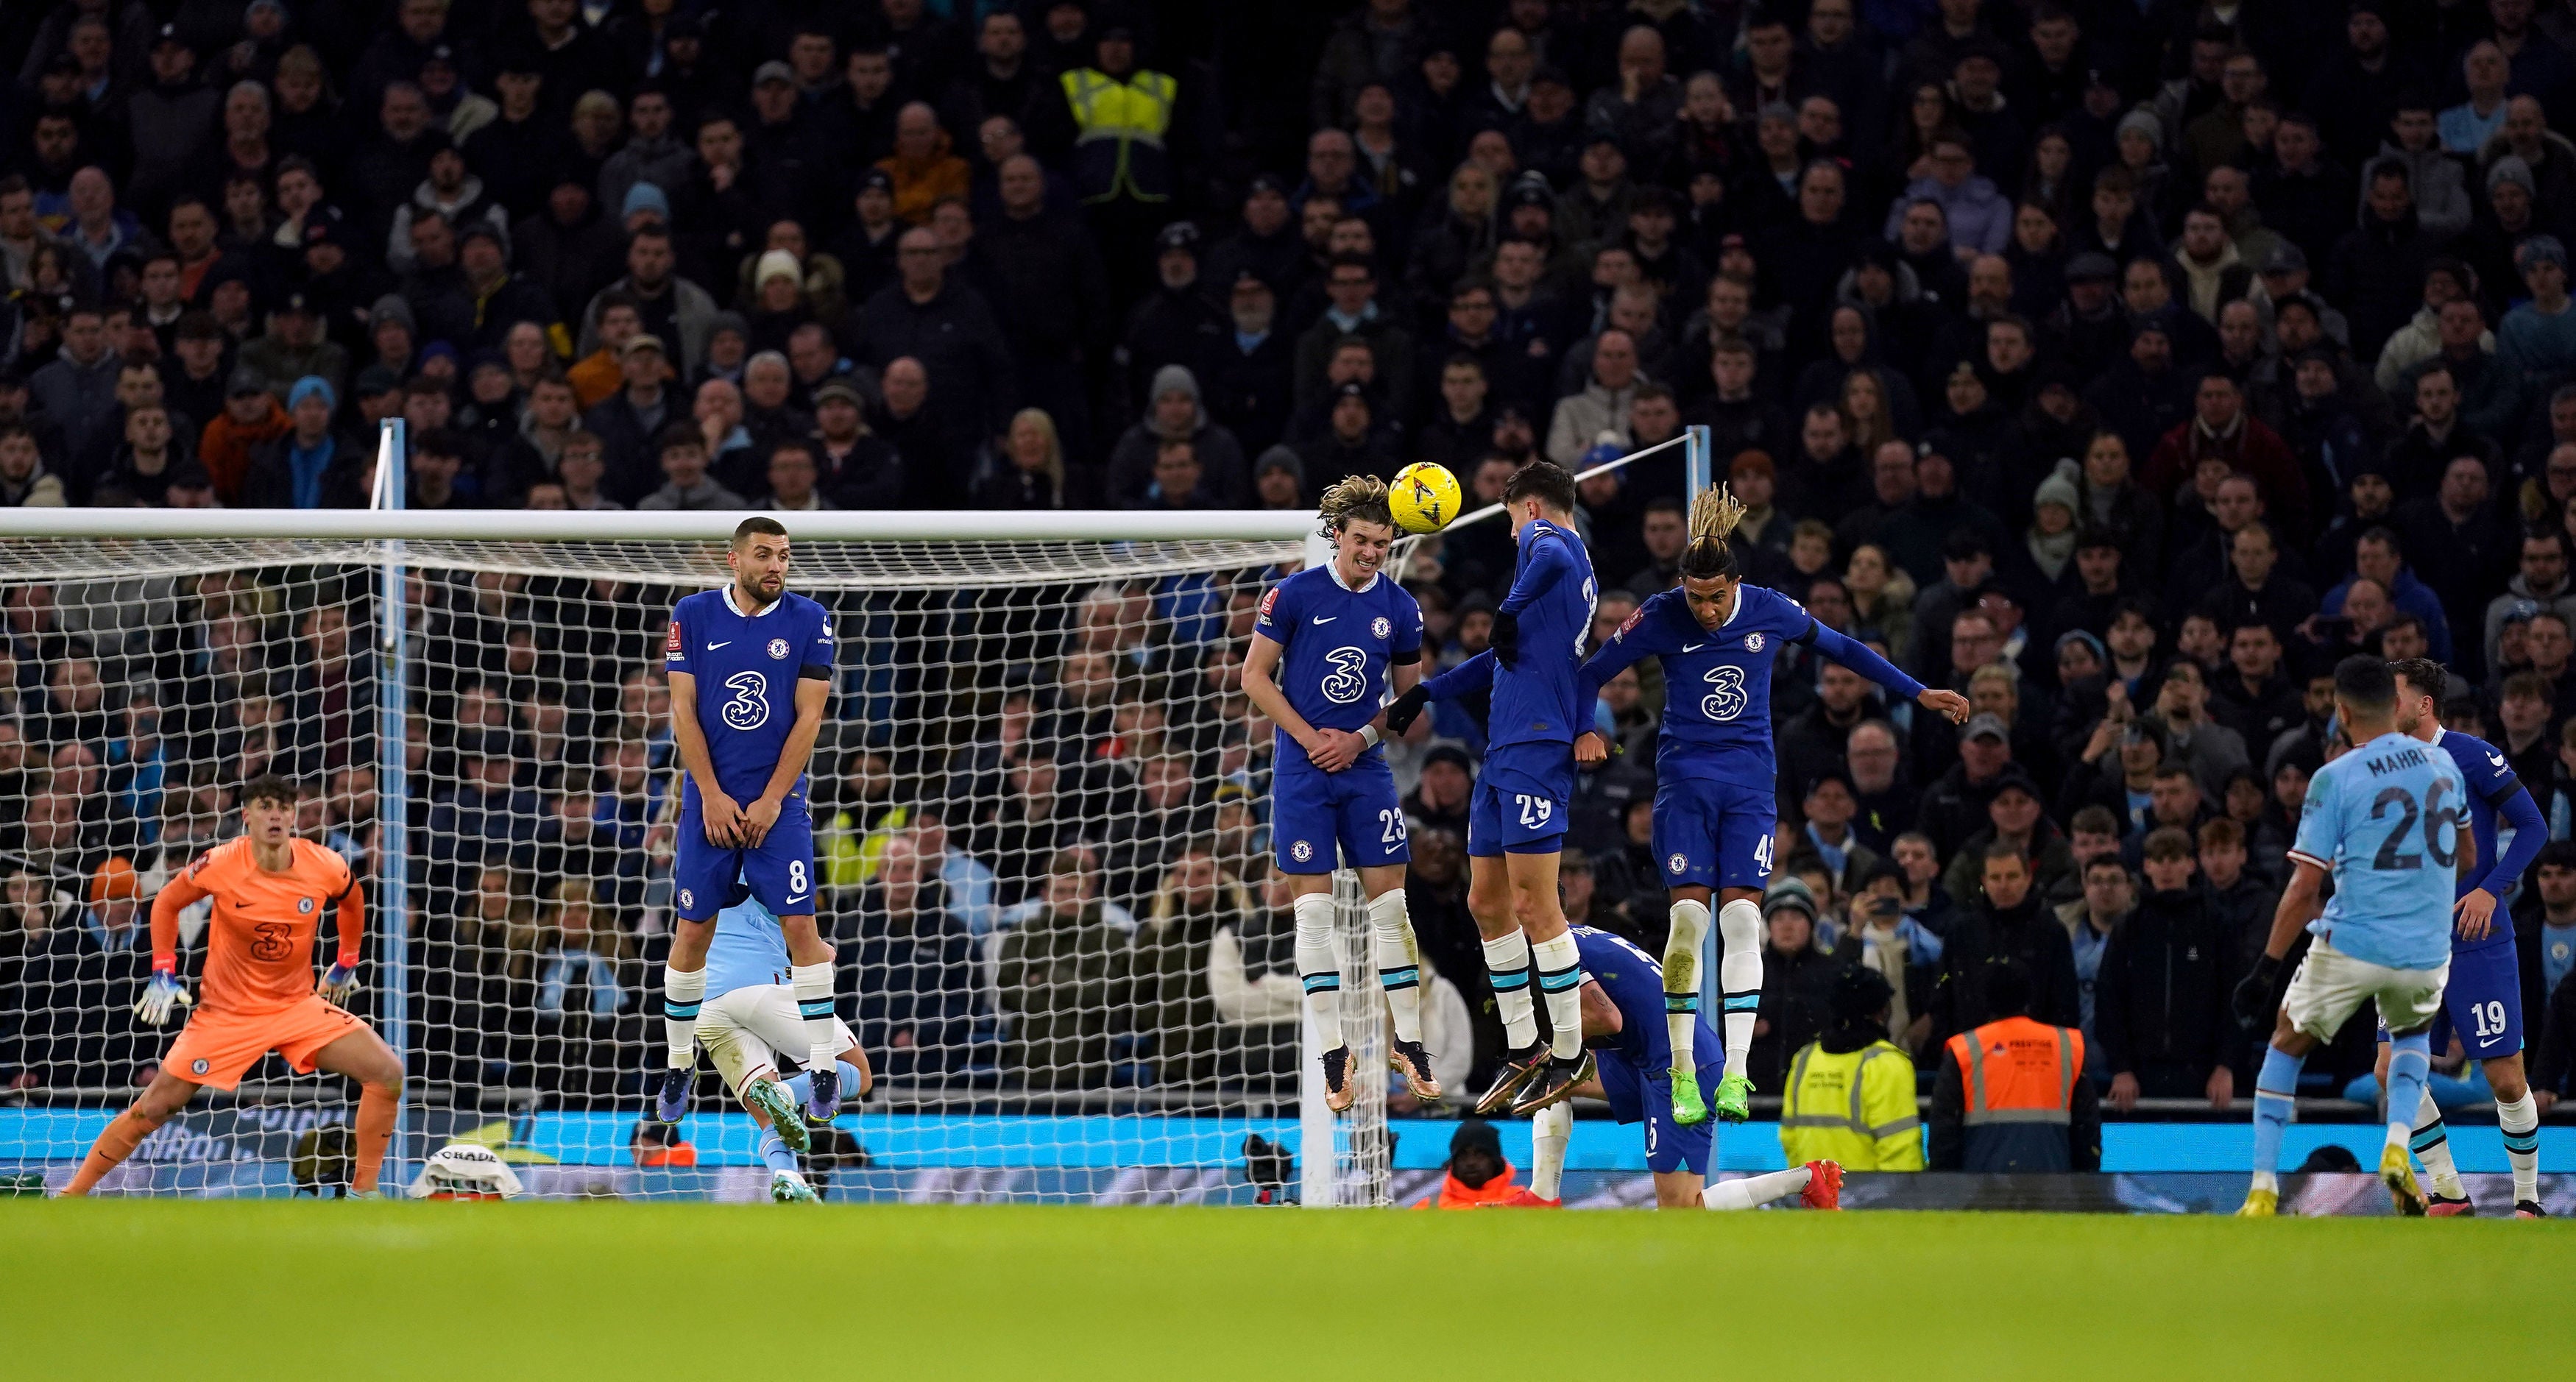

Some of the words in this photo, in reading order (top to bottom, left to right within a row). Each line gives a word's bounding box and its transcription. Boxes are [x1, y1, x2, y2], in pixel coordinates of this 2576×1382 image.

[1321, 646, 1367, 704] 3
[1701, 665, 1748, 721] 3
[722, 670, 770, 731] 3
[1379, 807, 1406, 843] 23
[1516, 794, 1551, 824] 29
[2371, 776, 2458, 870] 26
[1753, 833, 1774, 871] 42
[789, 860, 807, 893] 8
[251, 921, 293, 961] 3
[2471, 1001, 2505, 1036] 19
[1649, 1116, 1657, 1150] 5
